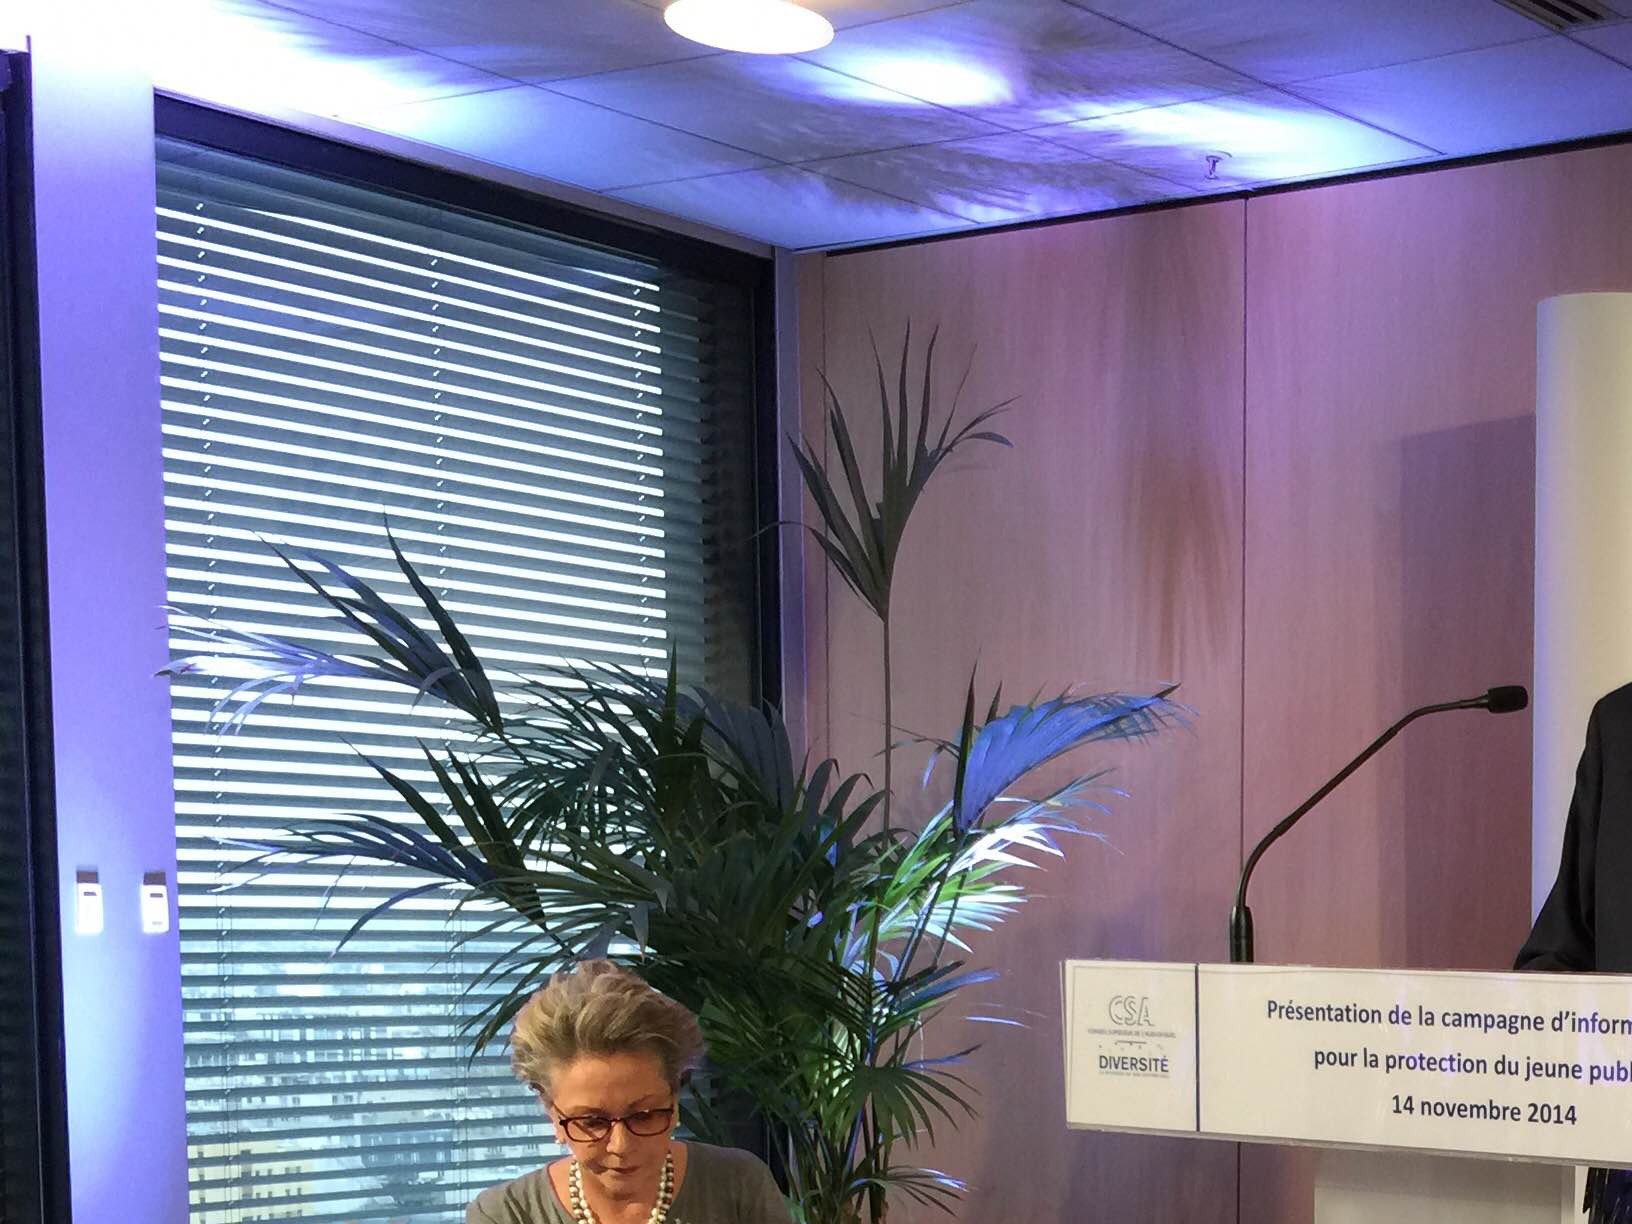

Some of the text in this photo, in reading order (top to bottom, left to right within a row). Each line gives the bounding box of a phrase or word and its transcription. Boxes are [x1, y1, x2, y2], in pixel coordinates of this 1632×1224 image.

[1108, 995, 1156, 1027] CSA
[1267, 999, 1382, 1024] Présentation
[1388, 1004, 1412, 1026] de
[1418, 1005, 1435, 1027] la
[1441, 1010, 1545, 1035] campagne
[1099, 1054, 1169, 1073] DIVERSITÉ
[1314, 1049, 1357, 1070] pour
[1363, 1047, 1379, 1068] la
[1385, 1052, 1487, 1075] protection
[1494, 1054, 1519, 1075] du
[1525, 1056, 1582, 1081] jeune
[1392, 1094, 1577, 1125] 14 novembre 2014
